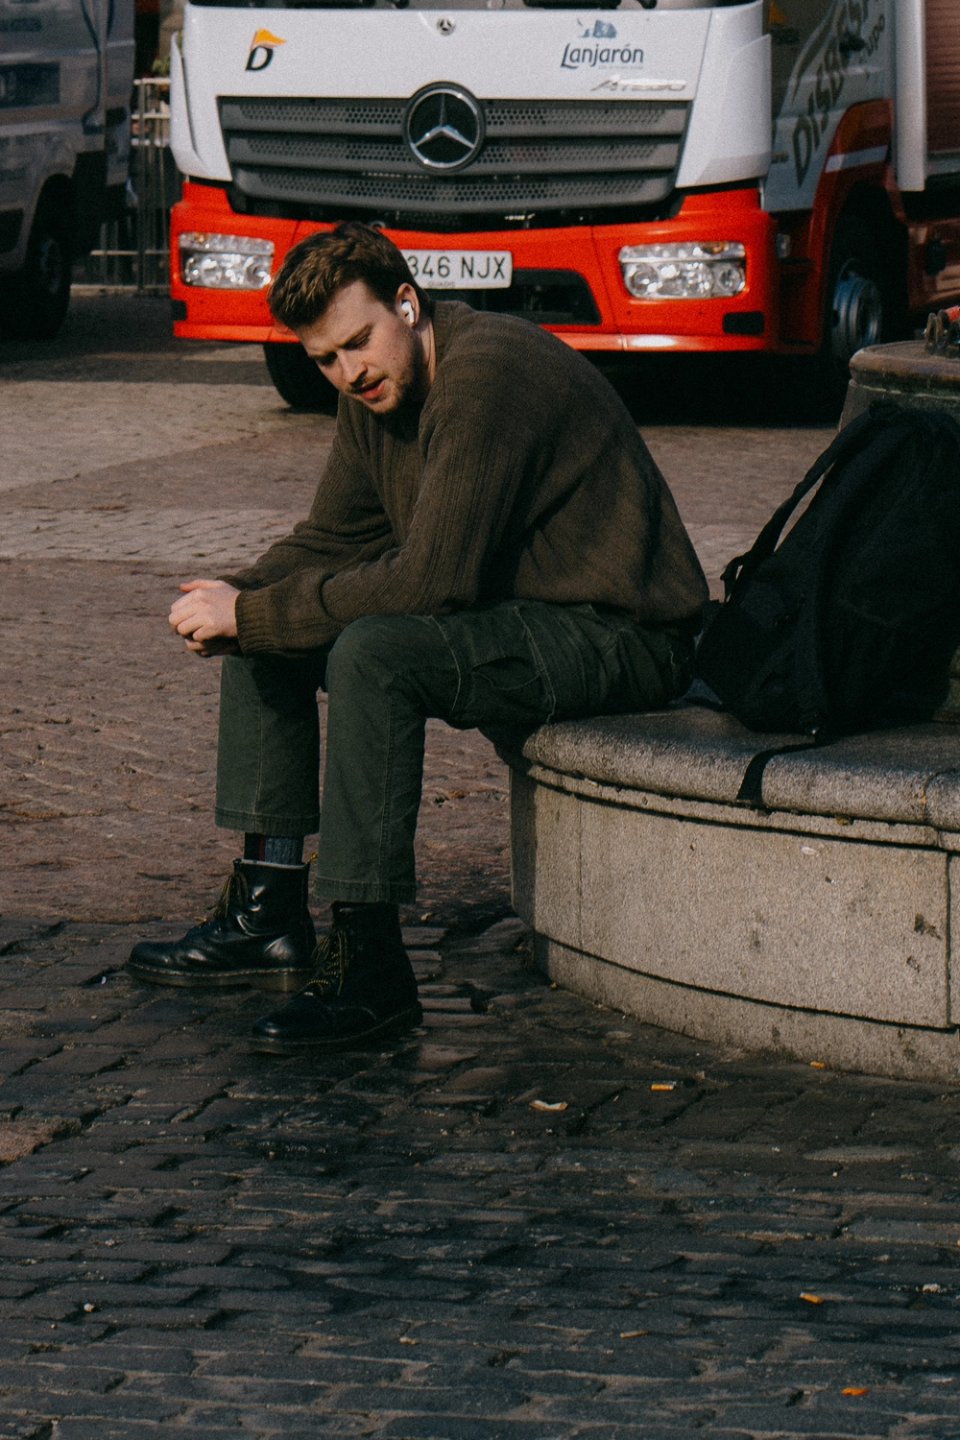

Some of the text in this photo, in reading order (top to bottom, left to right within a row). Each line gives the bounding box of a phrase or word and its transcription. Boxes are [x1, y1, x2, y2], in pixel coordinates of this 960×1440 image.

[559, 42, 645, 70] Lanjarón
[407, 255, 506, 279] 346 NJX
